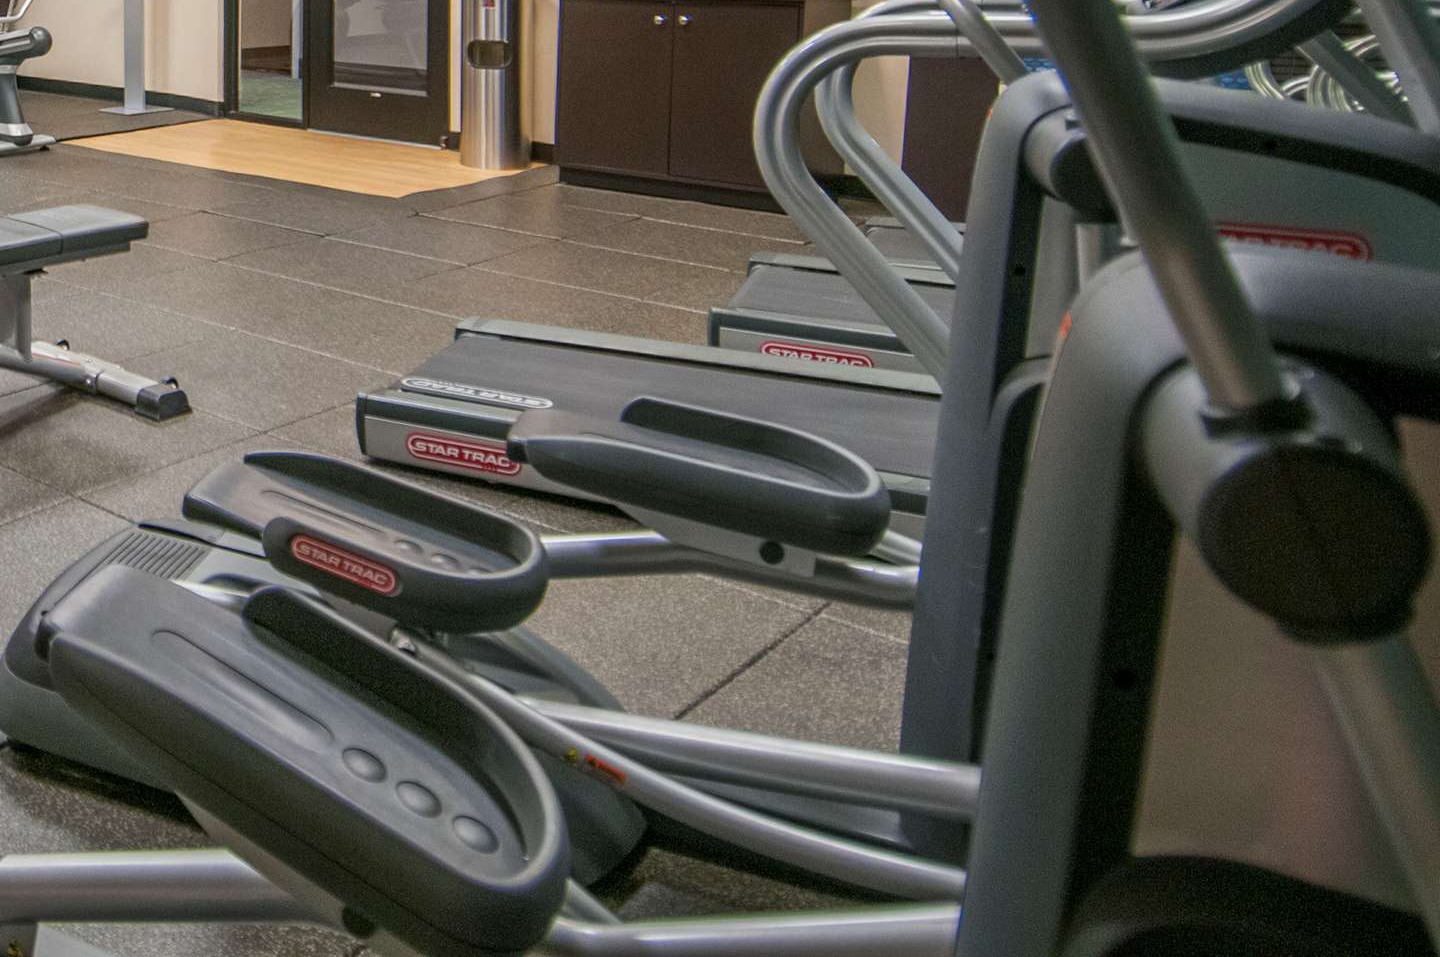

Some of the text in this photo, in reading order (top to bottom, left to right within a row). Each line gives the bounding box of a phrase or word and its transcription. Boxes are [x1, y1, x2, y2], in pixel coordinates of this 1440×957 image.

[414, 441, 511, 468] STAR TRAC
[298, 543, 389, 585] STAR TRAC
